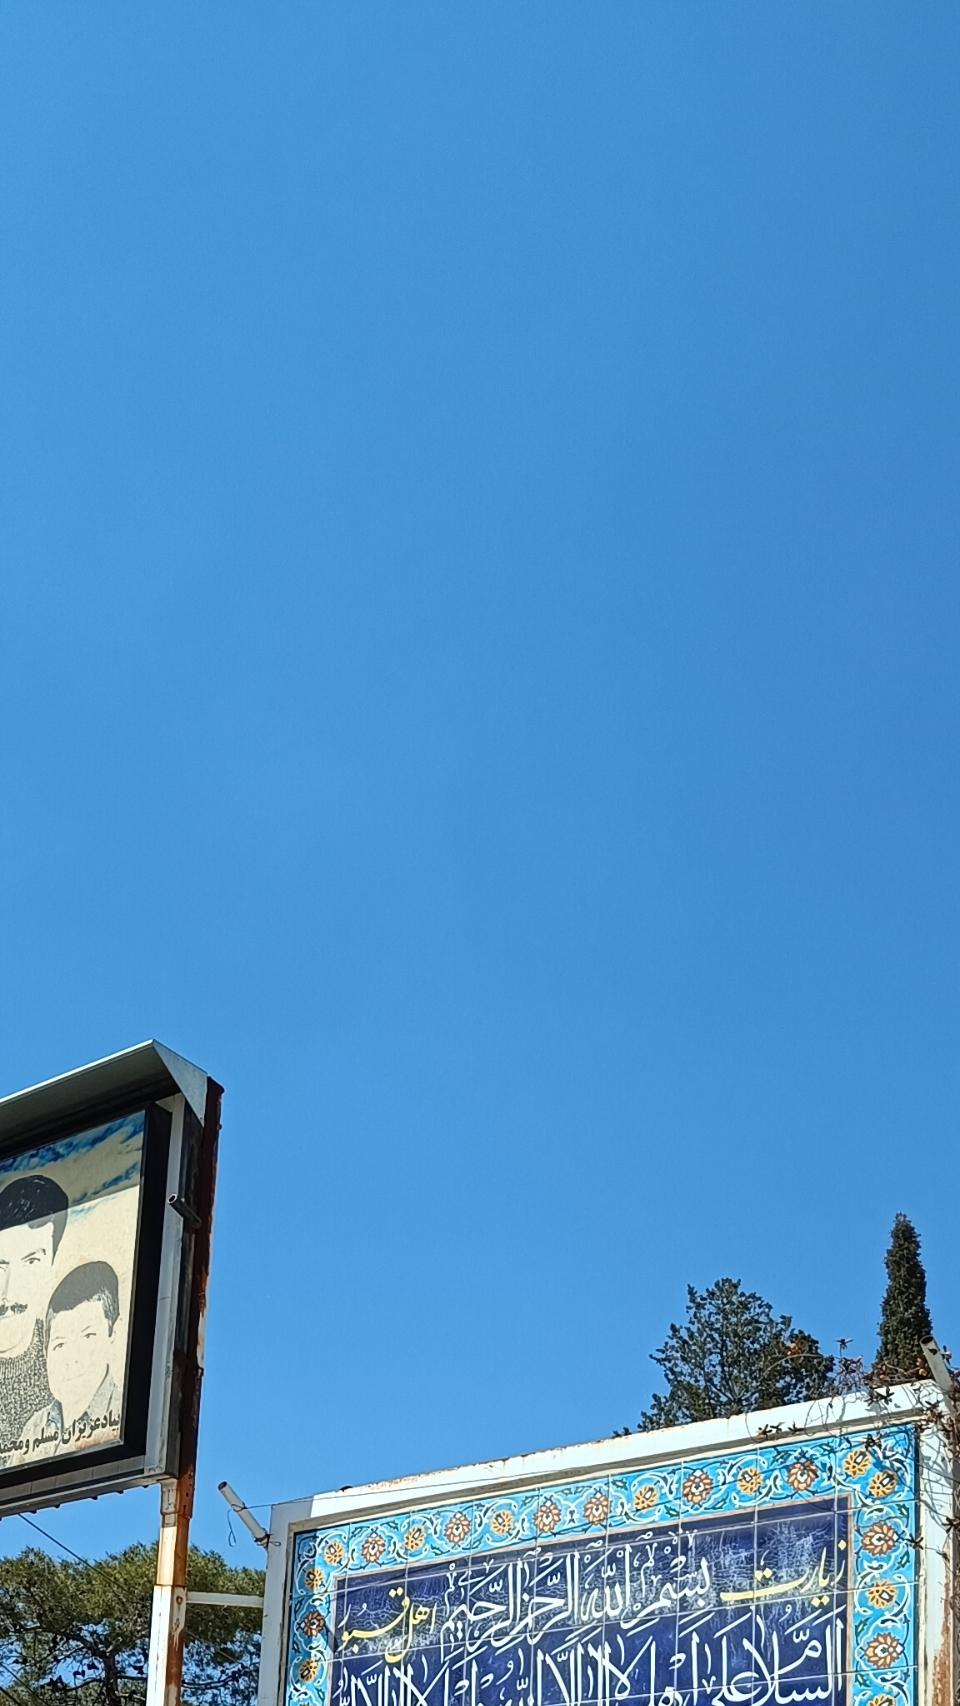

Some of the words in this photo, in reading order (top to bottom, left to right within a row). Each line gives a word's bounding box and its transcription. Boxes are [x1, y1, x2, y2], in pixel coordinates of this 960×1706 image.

[33, 1426, 59, 1448] مسلم
[720, 1539, 847, 1608] زیارت
[336, 1586, 410, 1654] قبور
